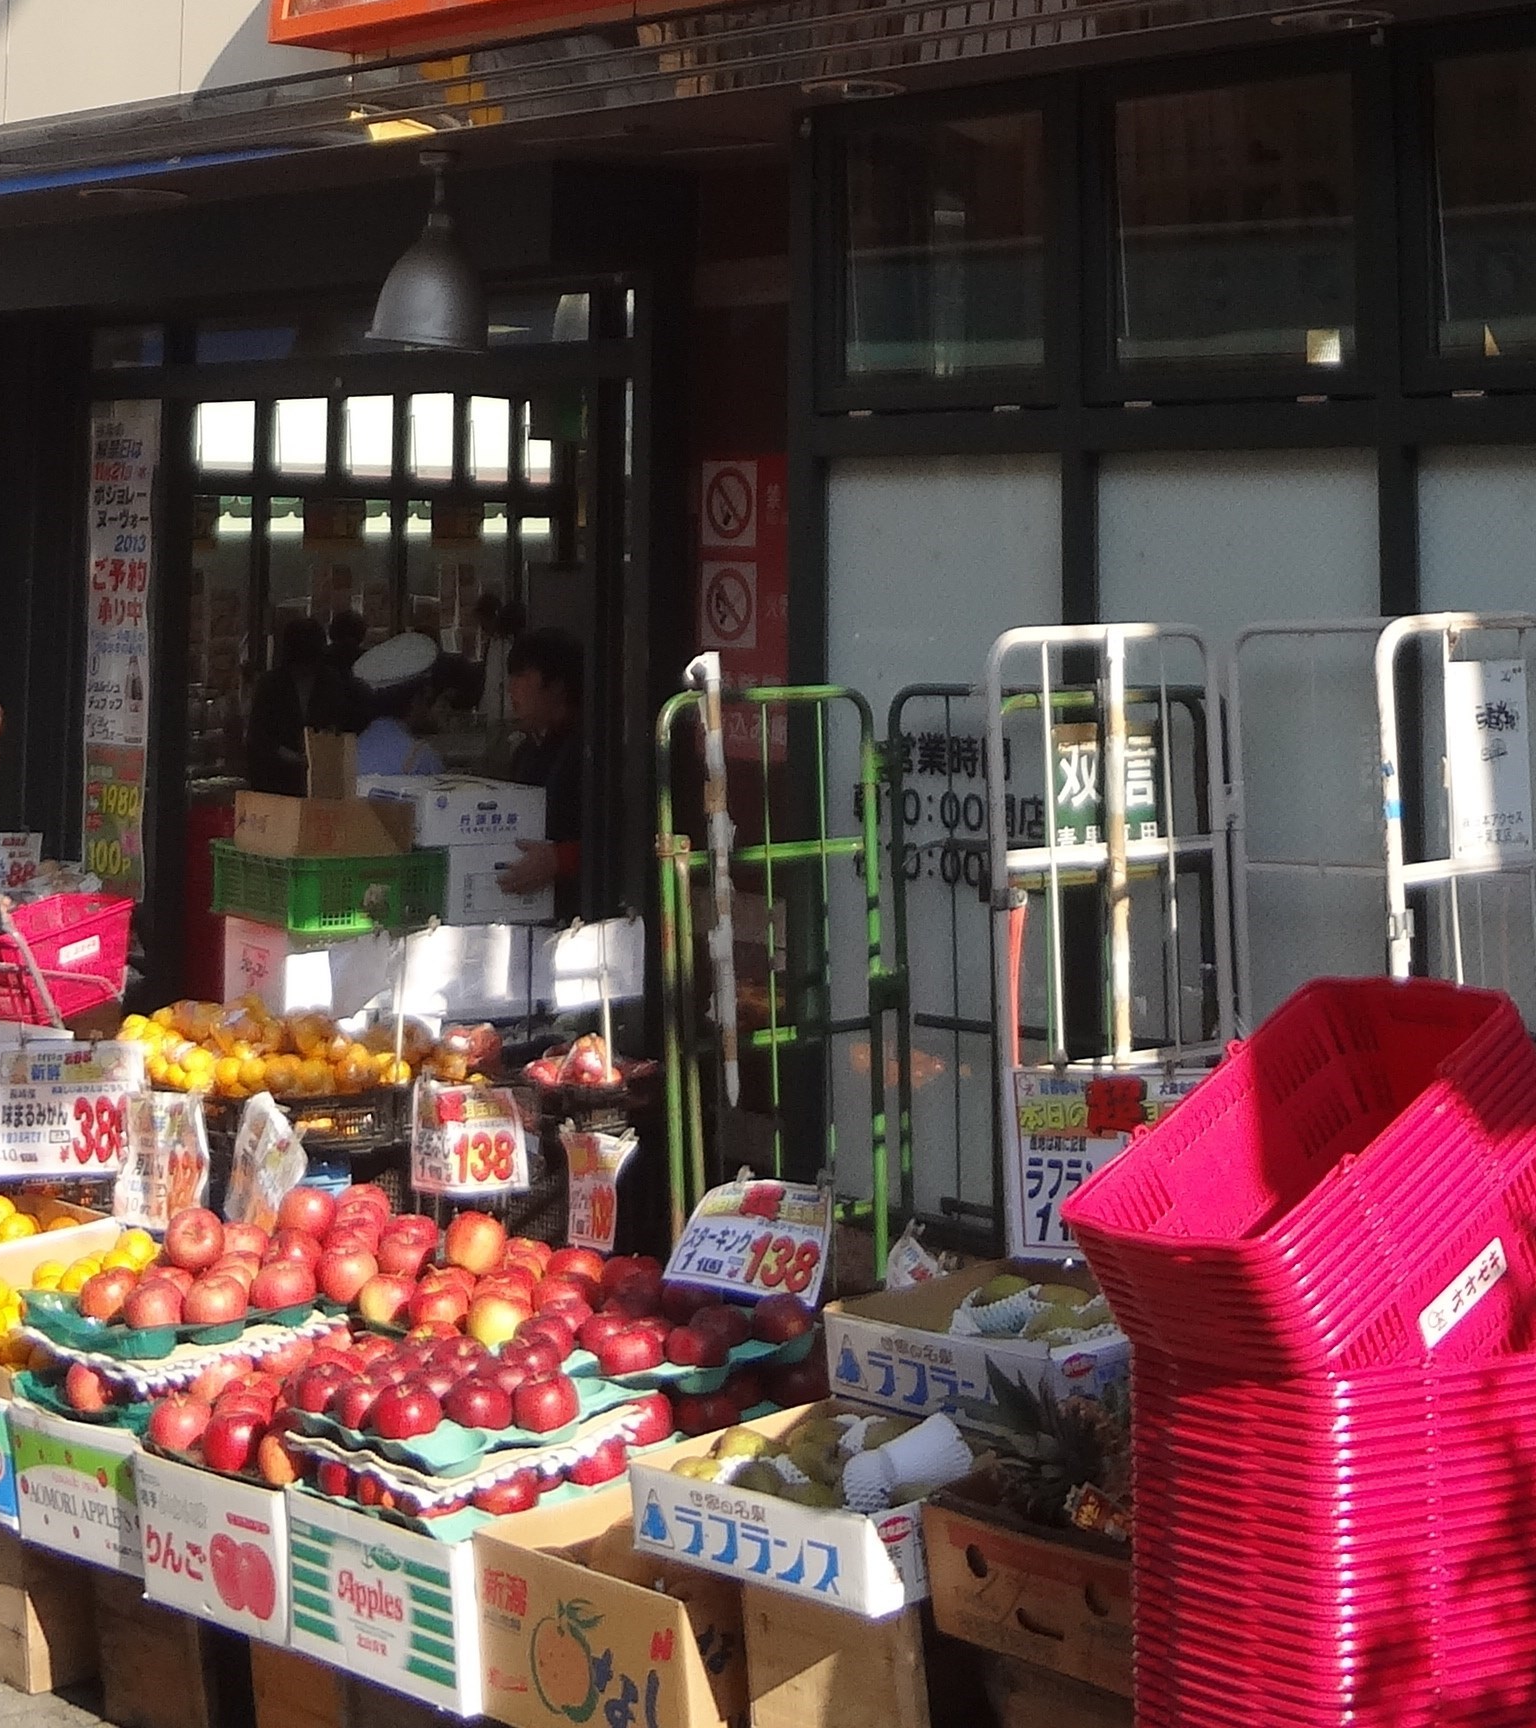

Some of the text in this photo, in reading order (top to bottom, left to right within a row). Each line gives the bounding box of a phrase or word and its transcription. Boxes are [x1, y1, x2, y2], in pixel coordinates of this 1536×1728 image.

[114, 534, 146, 554] 2013
[93, 558, 148, 594] ご予約
[97, 596, 144, 626] 承り中
[453, 1129, 515, 1184] 138
[683, 1226, 755, 1254] スターキング
[743, 1231, 821, 1293] 138
[1451, 1249, 1501, 1314] オオゼキ
[29, 1480, 79, 1518] AOMORI
[81, 1494, 134, 1535] APPLES
[146, 1523, 207, 1581] りんご
[674, 1505, 841, 1596] ラフランス
[337, 1569, 404, 1623] Apples
